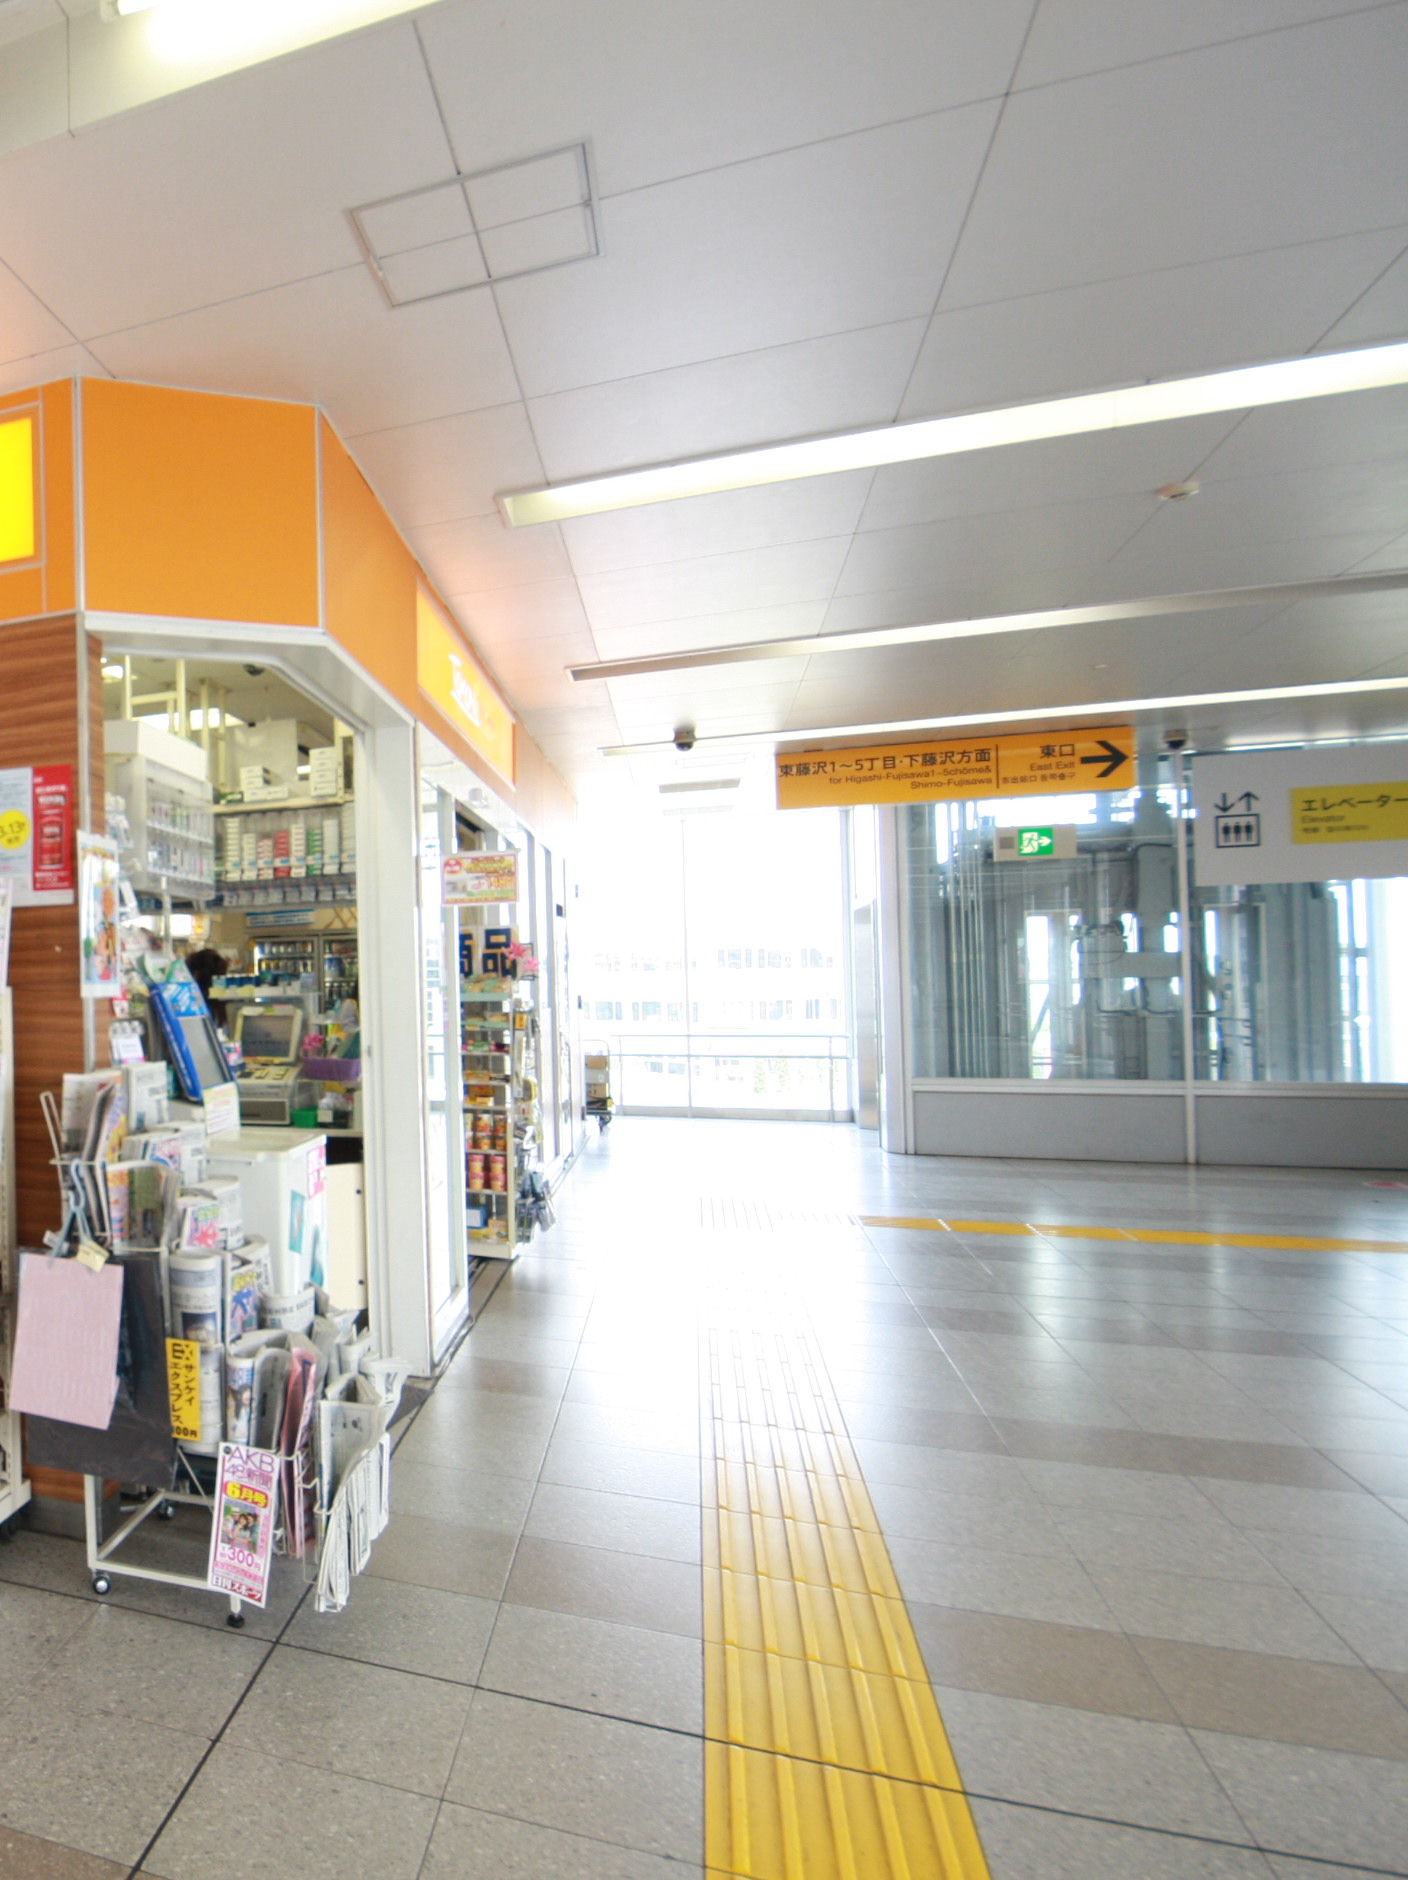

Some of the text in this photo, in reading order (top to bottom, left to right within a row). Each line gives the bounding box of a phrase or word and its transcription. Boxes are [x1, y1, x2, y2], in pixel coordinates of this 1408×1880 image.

[1039, 744, 1076, 759] 東口
[1030, 761, 1076, 772] East Exit
[829, 775, 842, 785] for
[910, 776, 993, 790] Shimo-Fujisawa
[170, 1361, 184, 1425] エクスプレス
[183, 1364, 196, 1406] サンケイ
[227, 1446, 275, 1474] AKB
[226, 1482, 268, 1508] 6月号
[212, 1575, 263, 1604] 日刊スポーツ
